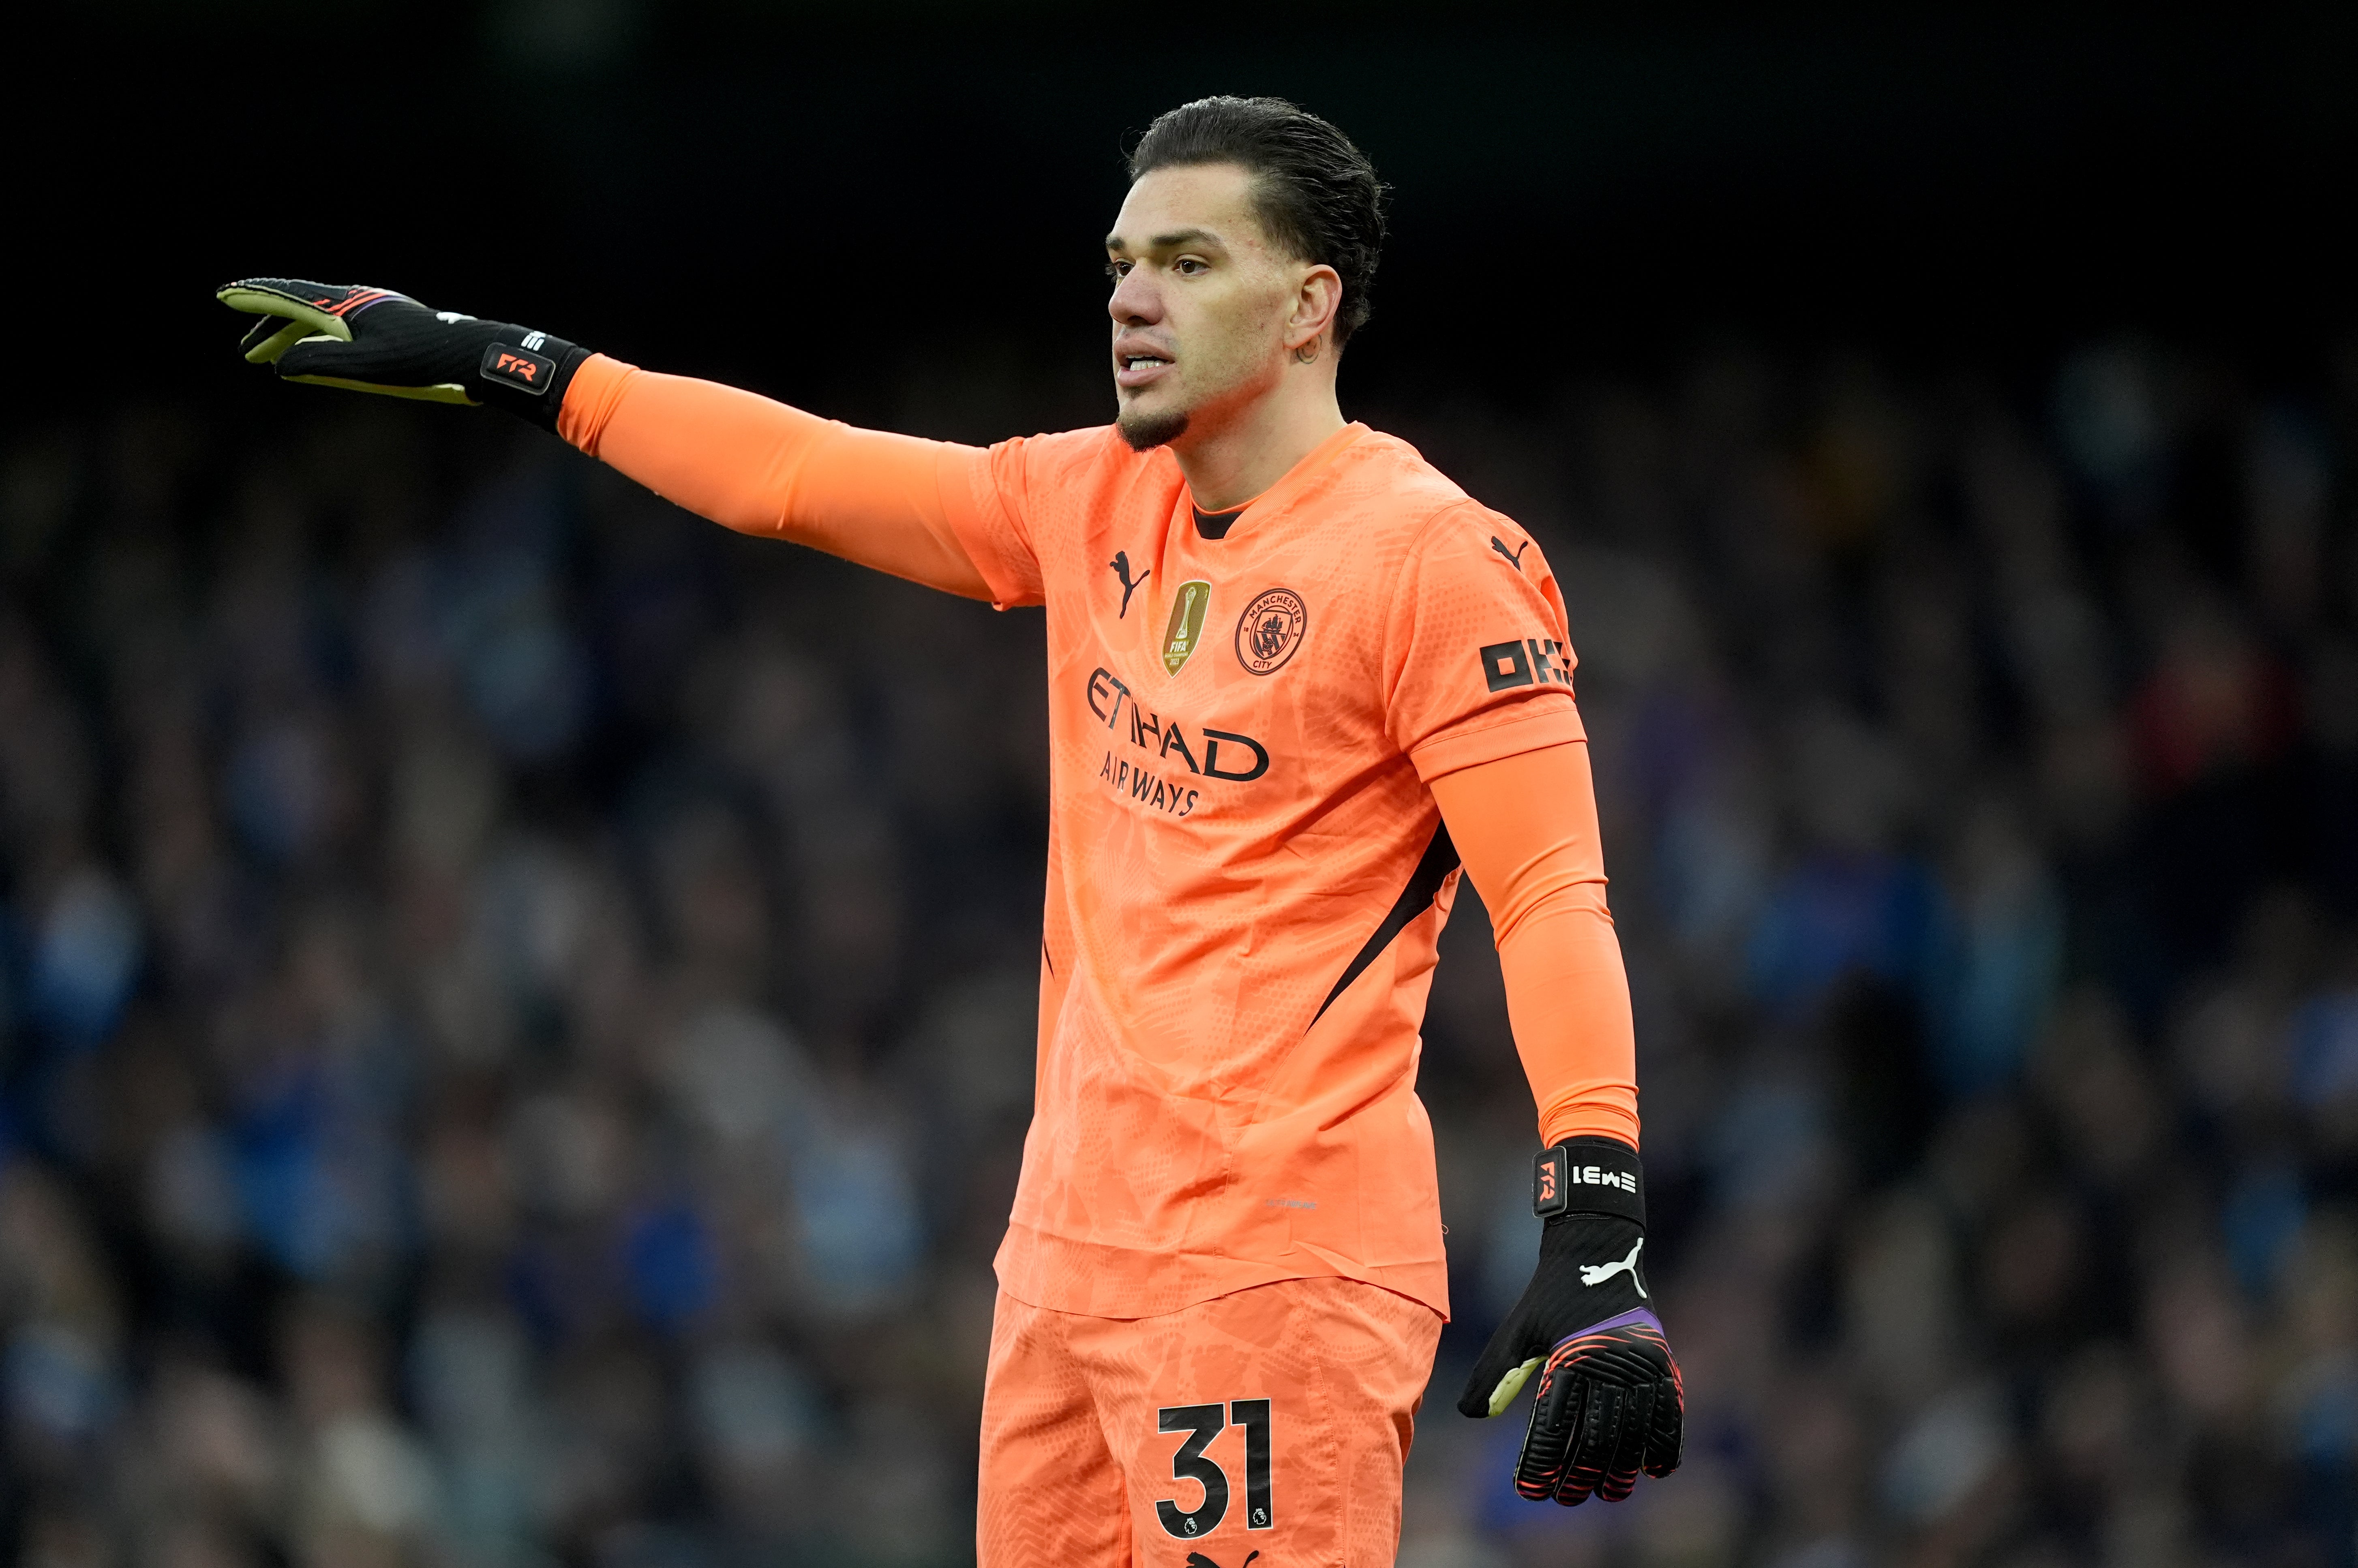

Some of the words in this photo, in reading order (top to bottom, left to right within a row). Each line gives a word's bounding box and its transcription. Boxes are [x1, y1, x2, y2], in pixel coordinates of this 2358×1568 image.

[1249, 595, 1301, 624] MANCHESTER
[1169, 641, 1186, 653] FIFA
[1253, 660, 1272, 669] CITY
[1087, 667, 1269, 782] ETIHAD
[1100, 751, 1199, 816] AIRWAYS
[1154, 1398, 1273, 1540] 31
